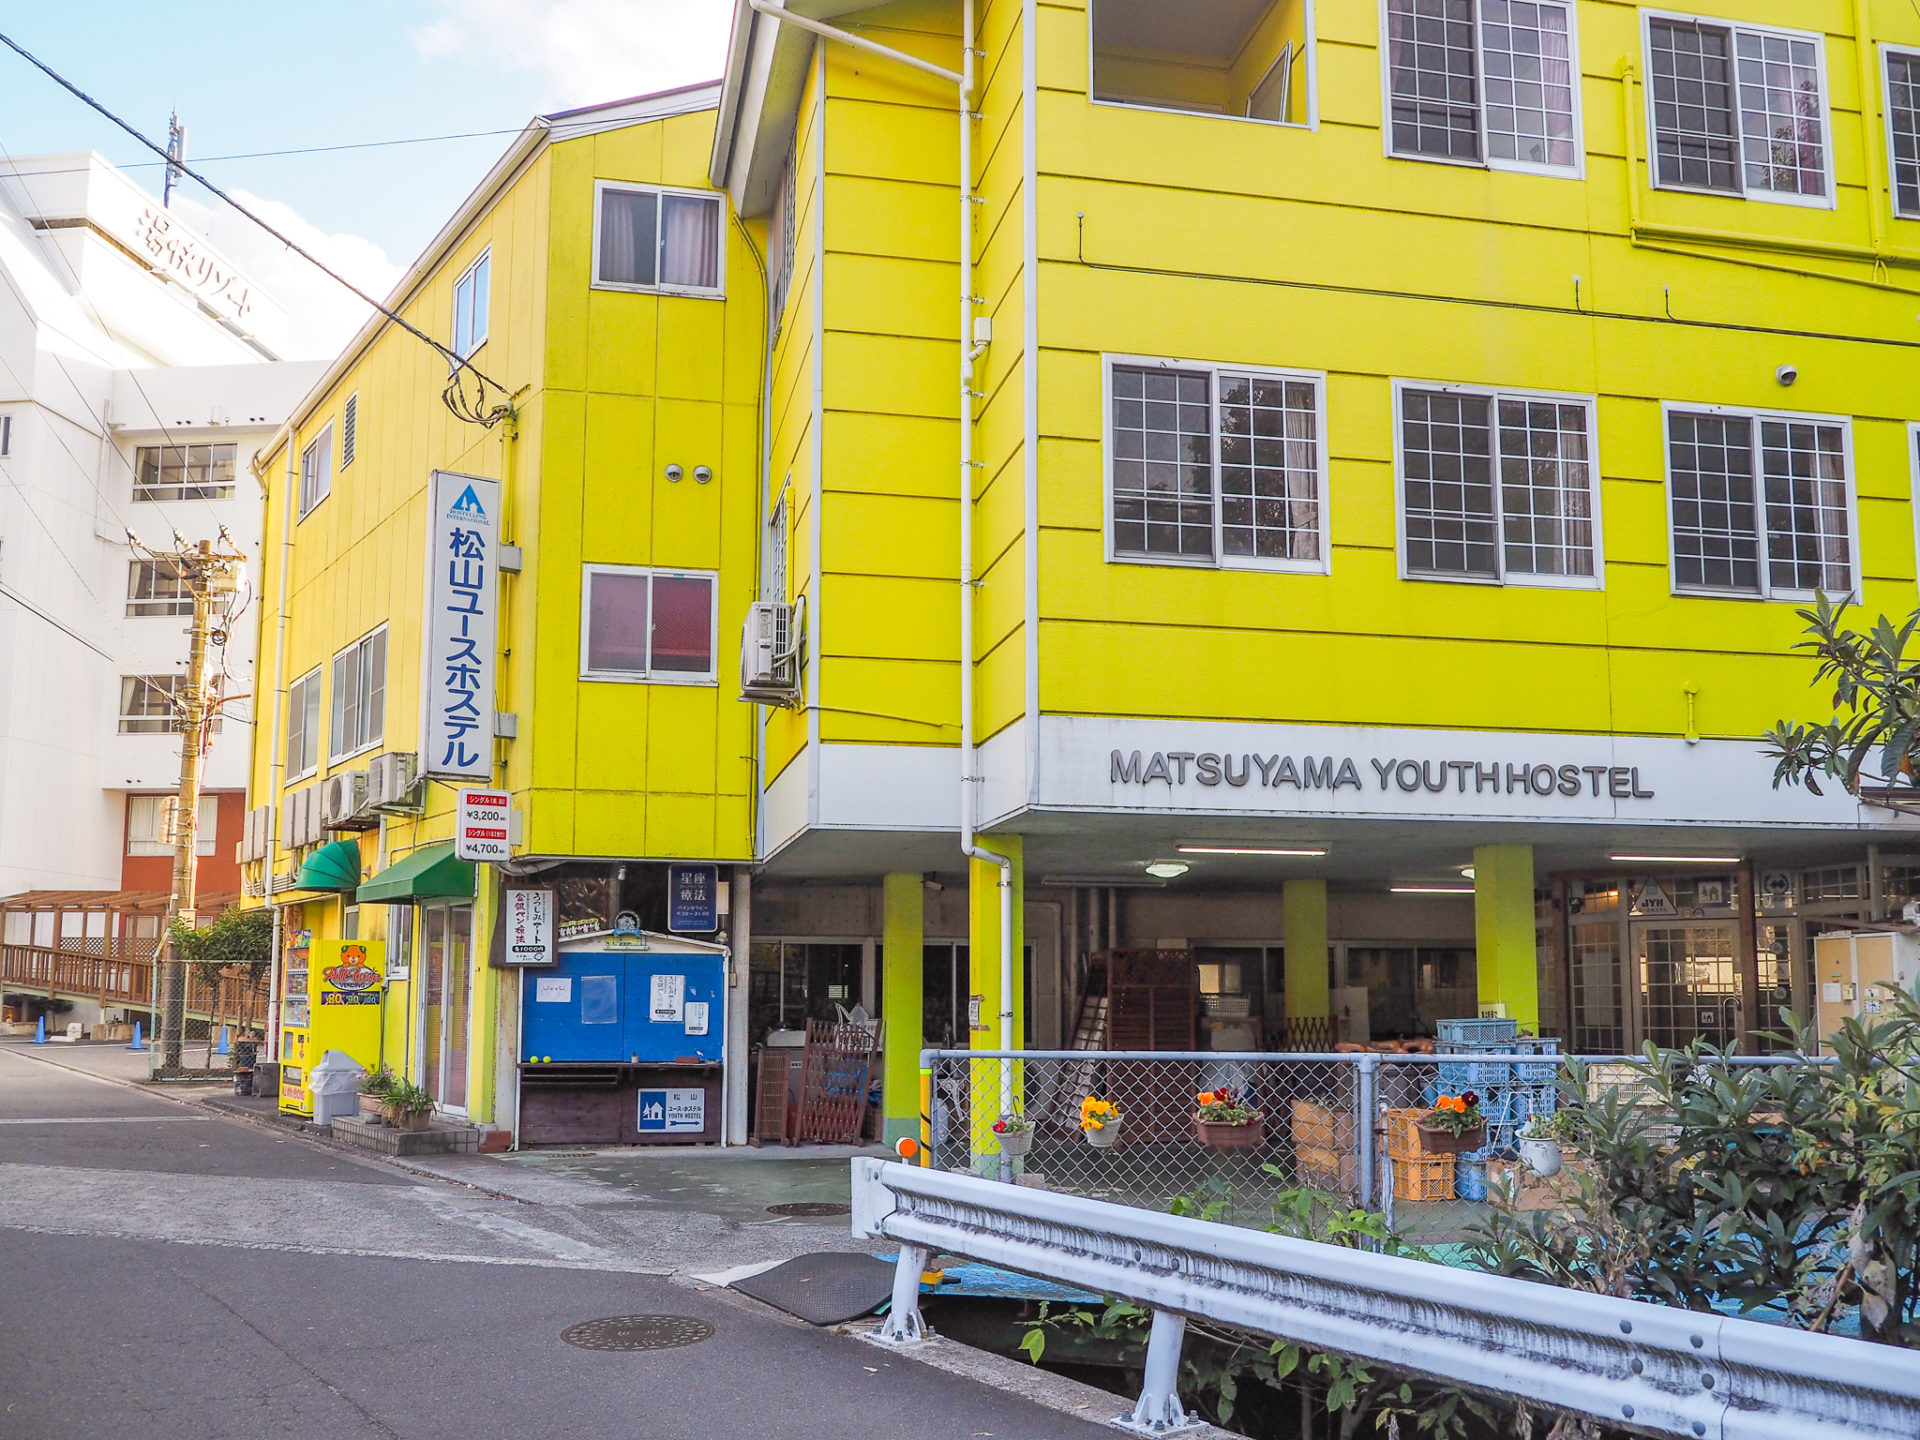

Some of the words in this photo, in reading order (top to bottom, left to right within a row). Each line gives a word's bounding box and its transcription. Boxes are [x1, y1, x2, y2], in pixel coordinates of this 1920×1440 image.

[446, 513, 491, 526] INTERNATIONAL
[450, 508, 486, 520] HOSTELLING
[442, 527, 486, 767] 松山ユースホステル
[1110, 749, 1362, 790] MATSUYAMA
[1371, 757, 1500, 794] YOUTH
[1506, 762, 1655, 798] HOSTEL
[466, 810, 499, 821] ¥3,200
[465, 843, 498, 854] ¥4,700
[1642, 899, 1664, 907] JYH
